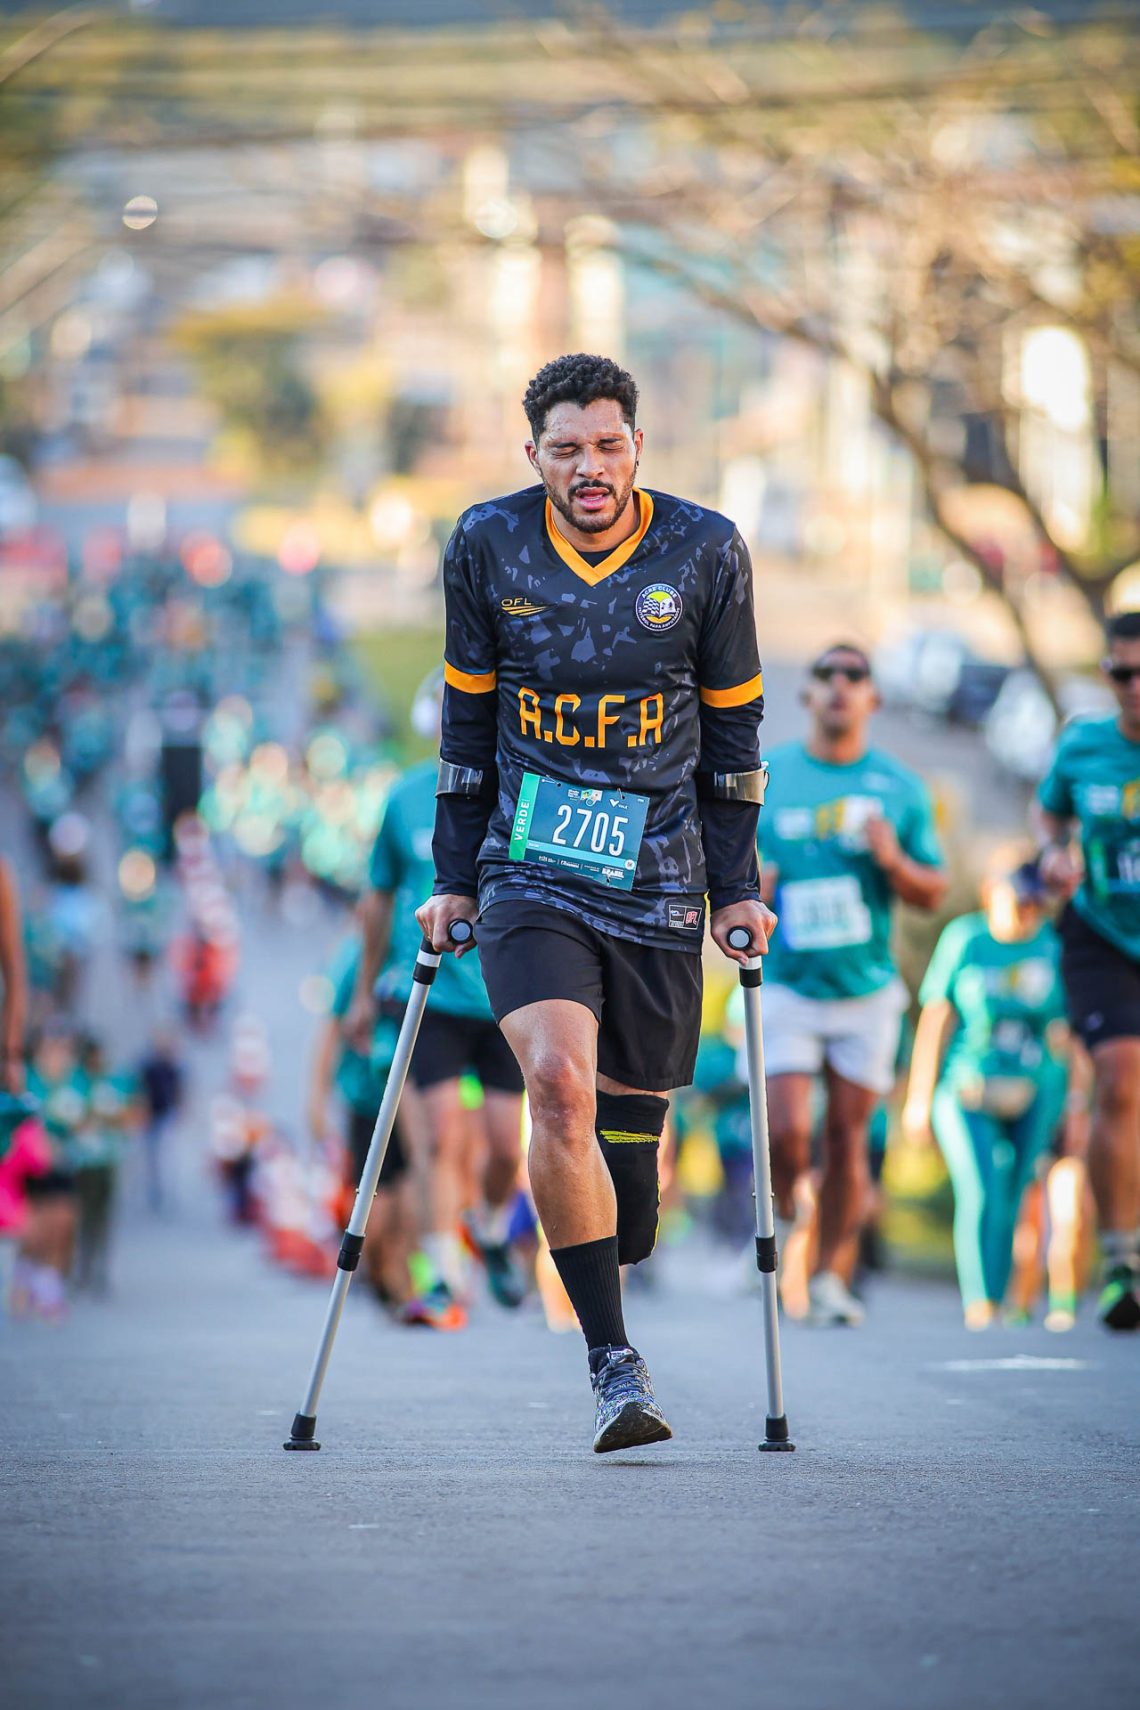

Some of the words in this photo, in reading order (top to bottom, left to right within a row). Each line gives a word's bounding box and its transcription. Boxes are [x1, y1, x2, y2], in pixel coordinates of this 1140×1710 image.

[501, 597, 532, 607] OFL
[641, 586, 657, 599] ACRE
[657, 586, 678, 599] CLUBE
[517, 686, 664, 749] A.C.F.A
[514, 801, 530, 841] VERDE
[552, 804, 629, 857] 2705
